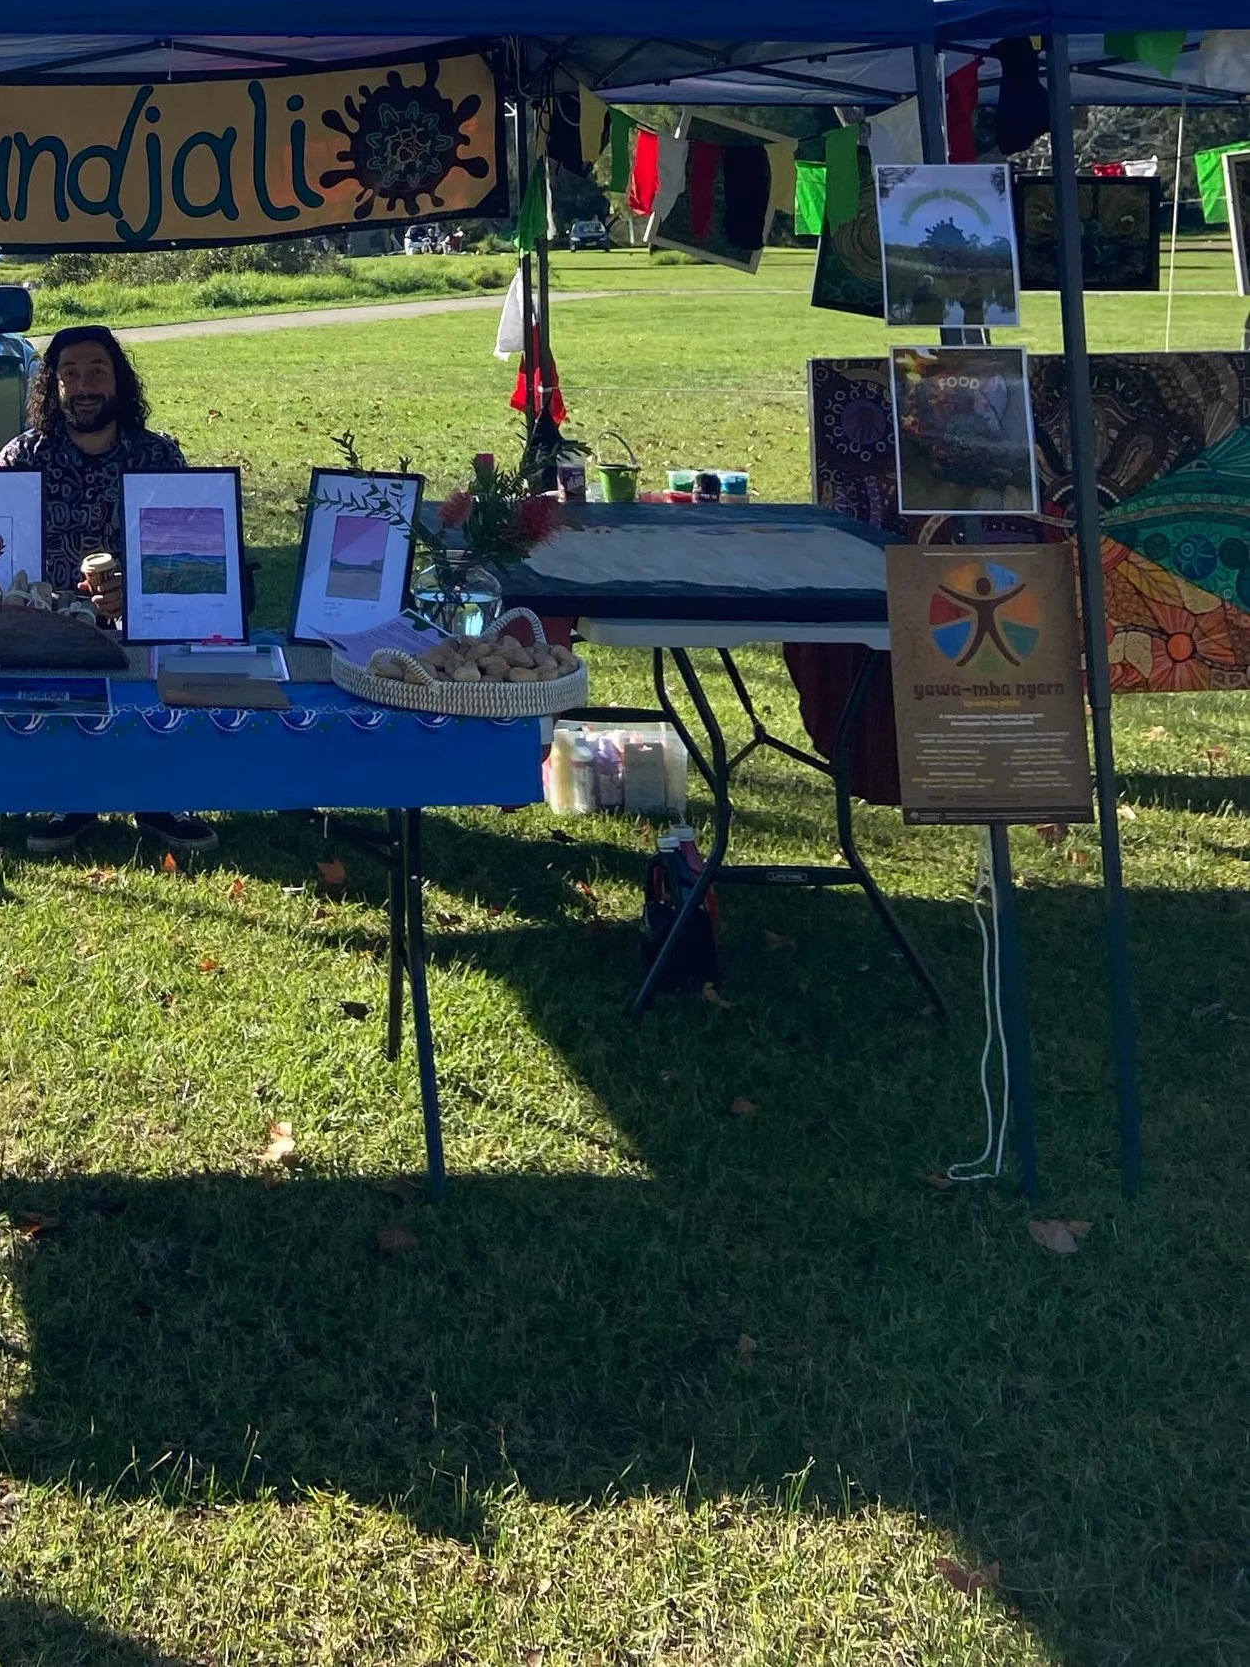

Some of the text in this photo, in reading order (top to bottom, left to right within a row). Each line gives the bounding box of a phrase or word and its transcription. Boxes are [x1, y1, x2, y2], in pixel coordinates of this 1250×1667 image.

[938, 376, 980, 391] FOOD
[914, 680, 1065, 700] yawa-mba ngarn
